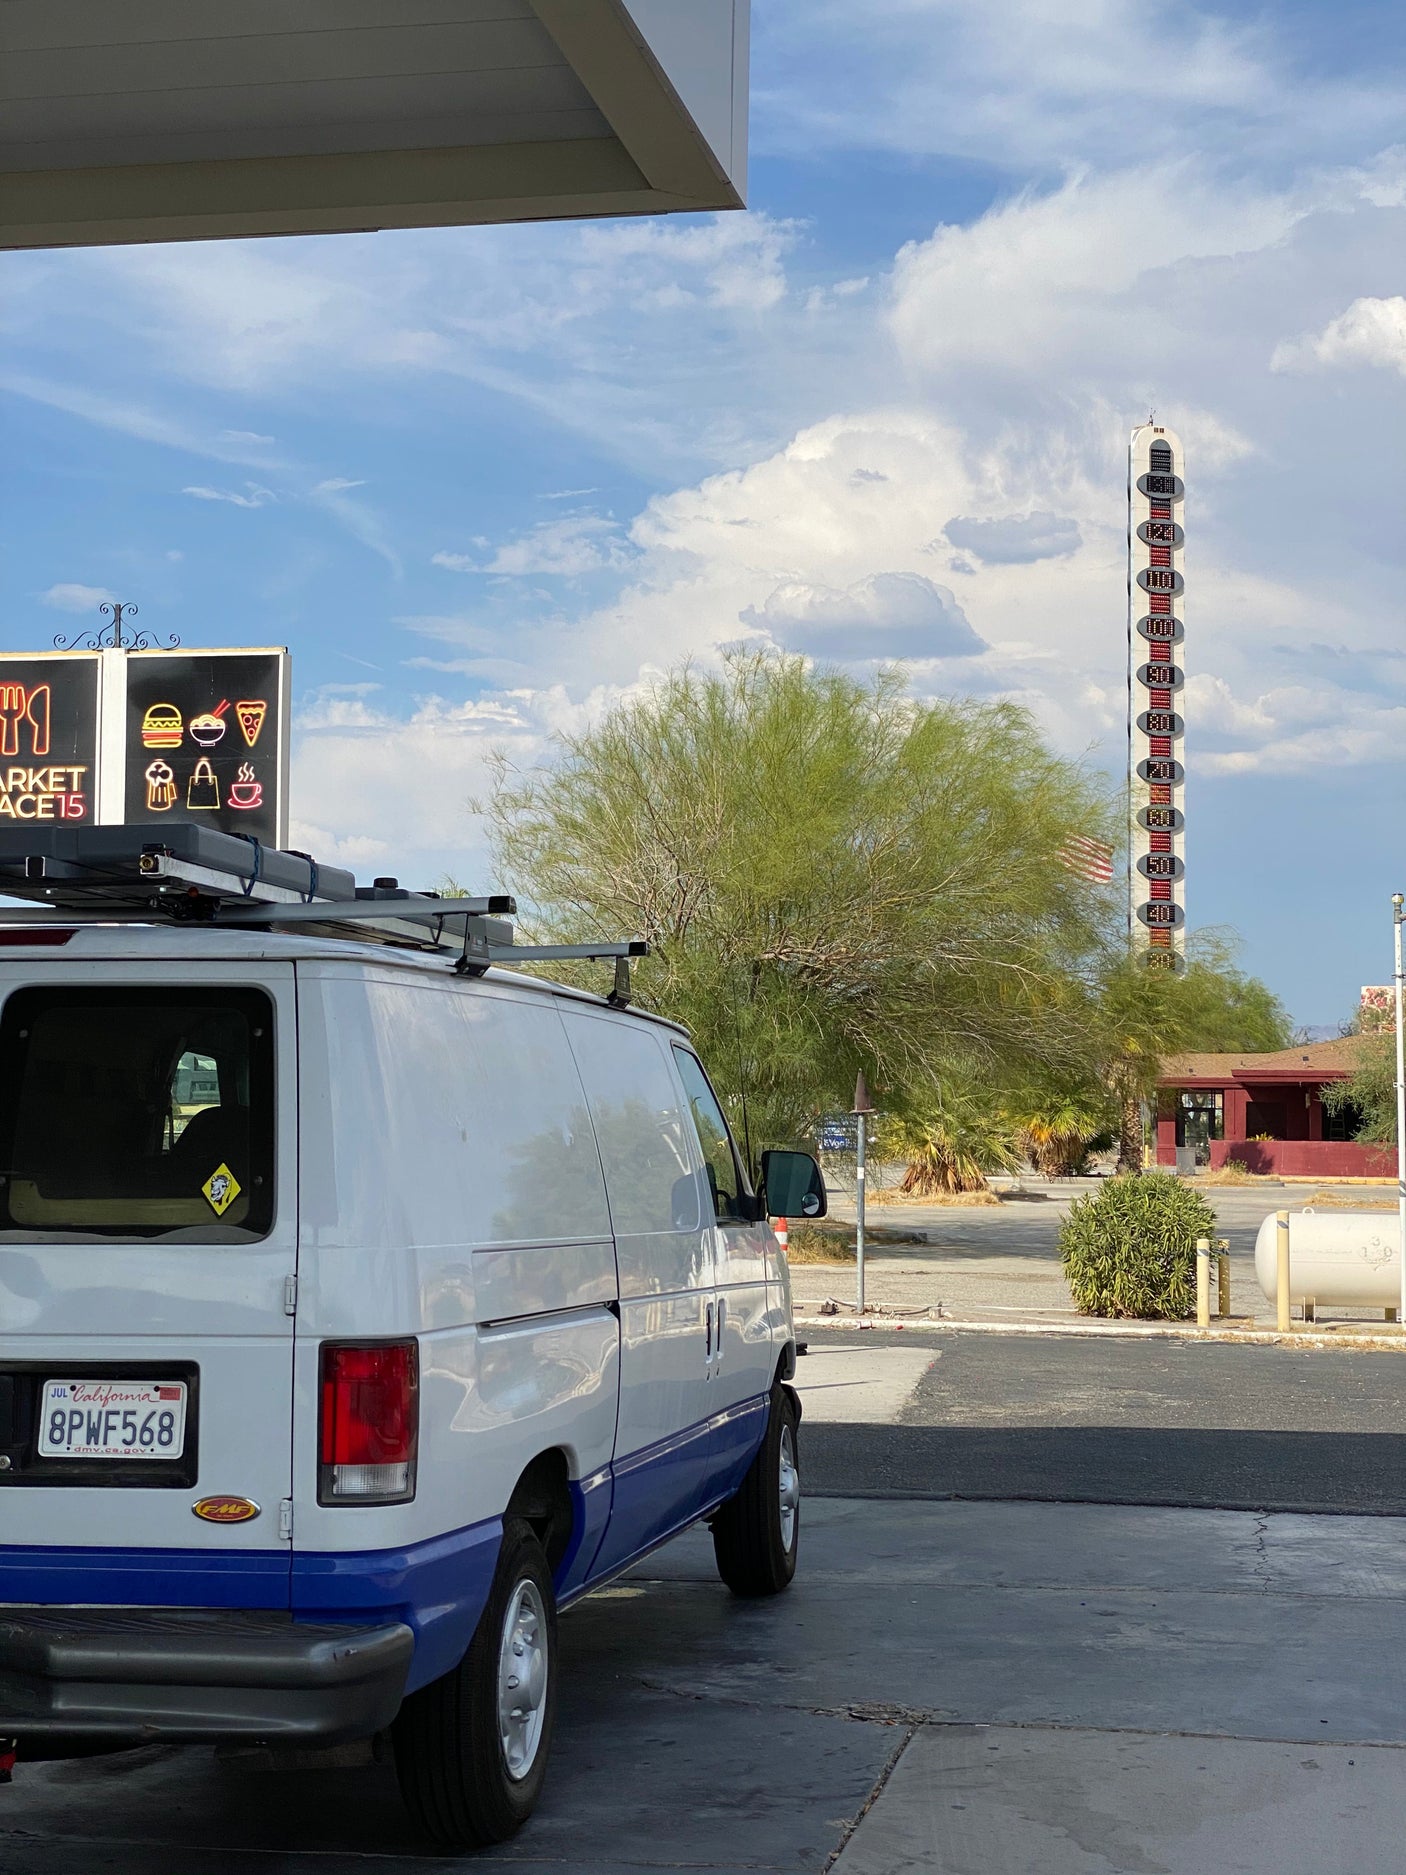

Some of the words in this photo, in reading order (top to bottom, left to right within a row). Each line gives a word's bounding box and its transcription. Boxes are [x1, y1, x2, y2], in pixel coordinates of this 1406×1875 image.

[1146, 523, 1174, 542] 124
[1147, 571, 1172, 589] 110
[1146, 618, 1174, 637] 100
[1149, 666, 1170, 683] 90
[1149, 713, 1171, 730] 80
[1149, 761, 1171, 779] 70
[1149, 809, 1171, 827] 60
[1149, 857, 1171, 875] 50
[1149, 904, 1171, 923] 40
[51, 1387, 68, 1398] JUL
[72, 1384, 160, 1408] California
[49, 1409, 175, 1447] 8PWF568
[73, 1446, 147, 1455] dmv.ca.gov
[202, 1503, 250, 1514] FMF
